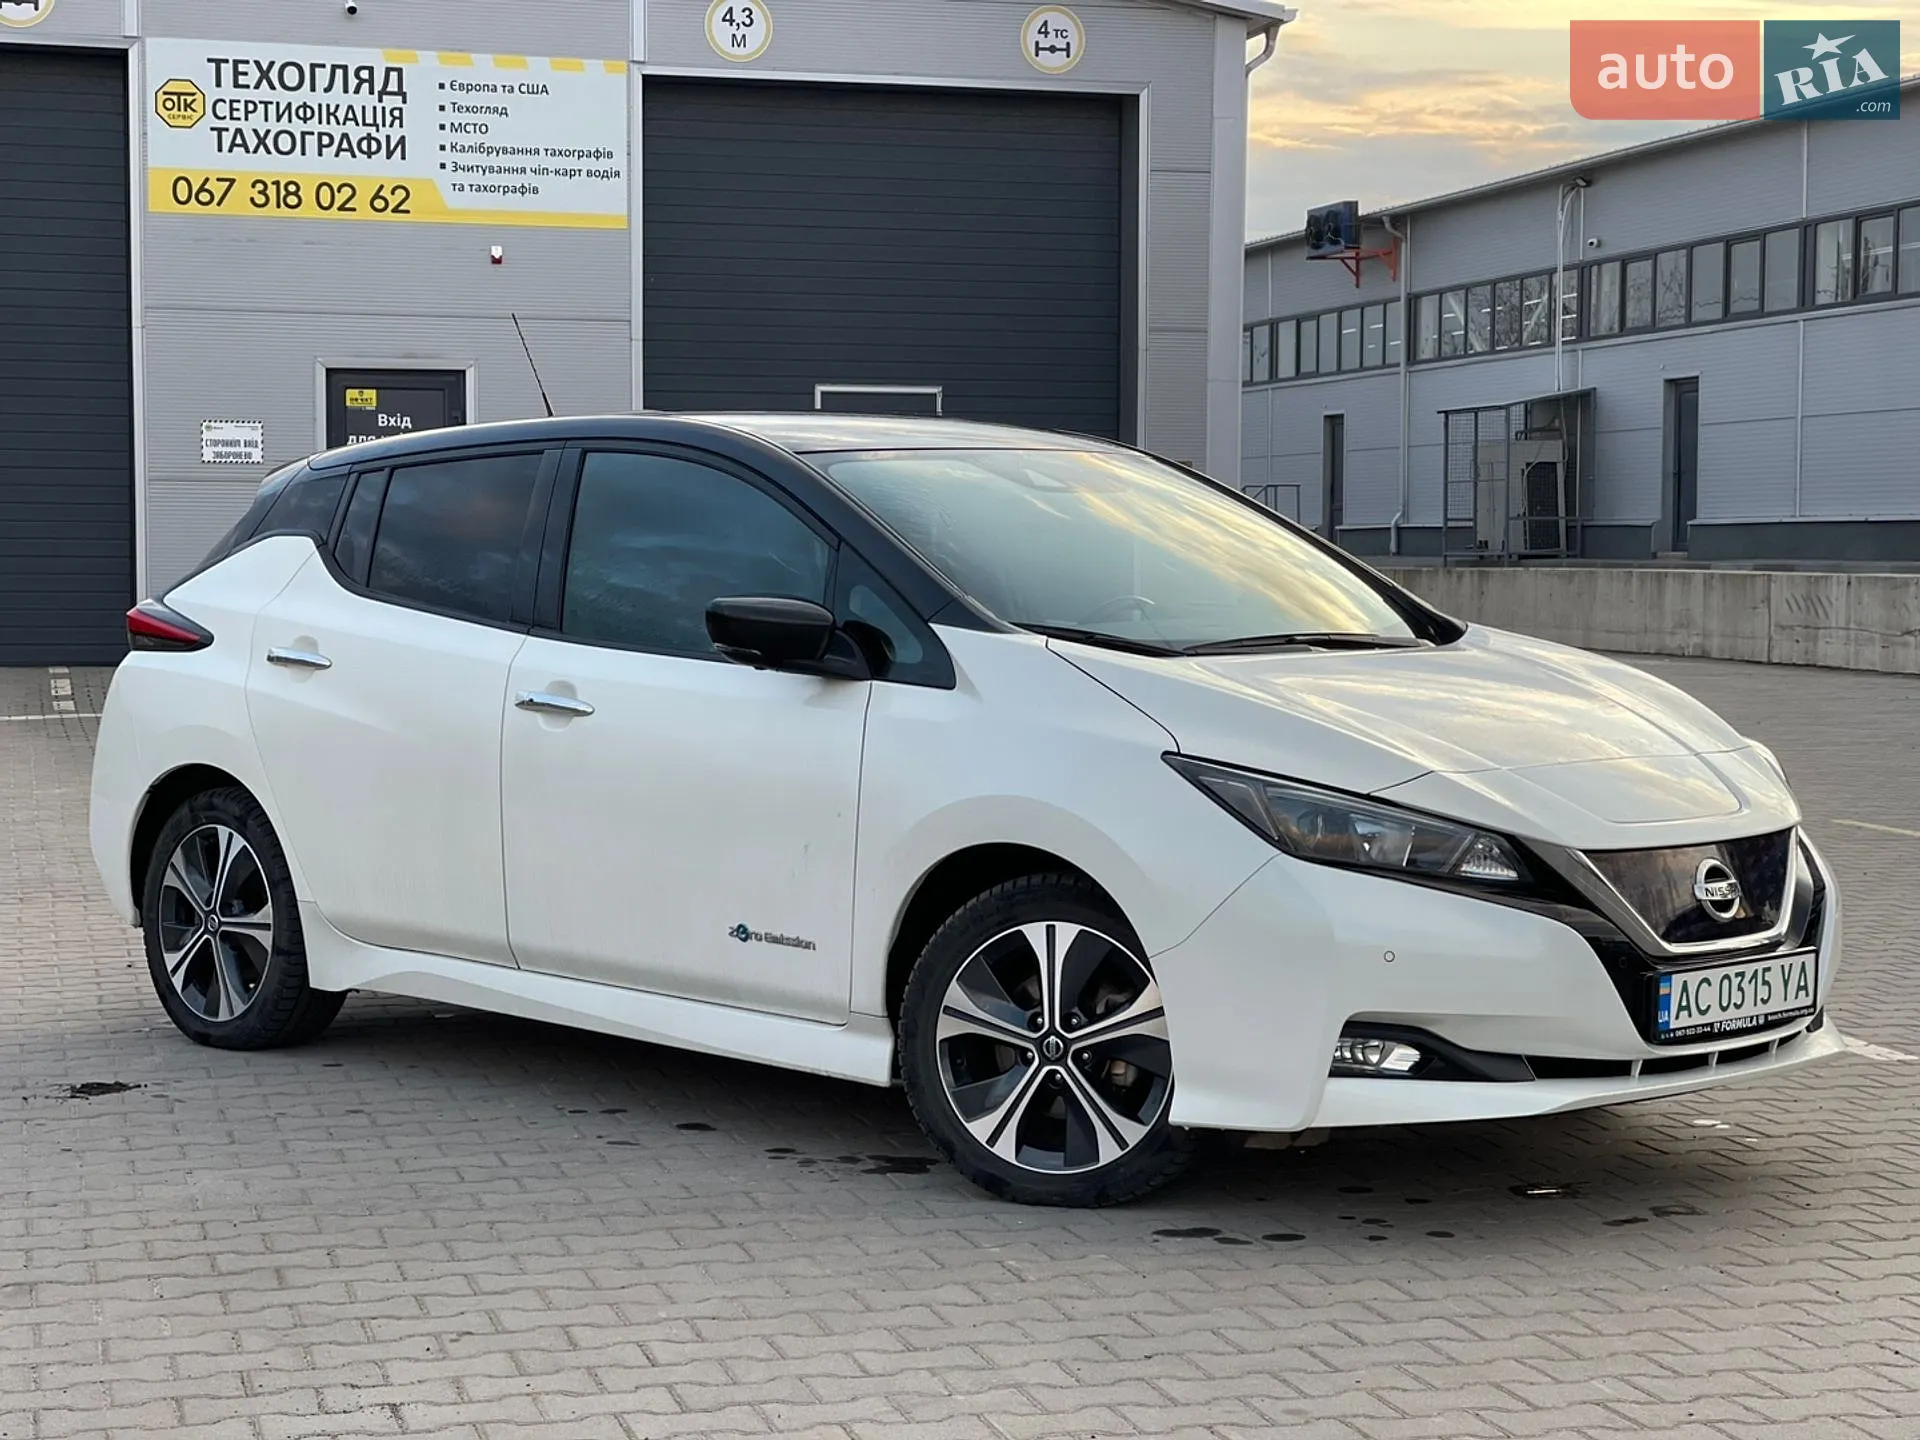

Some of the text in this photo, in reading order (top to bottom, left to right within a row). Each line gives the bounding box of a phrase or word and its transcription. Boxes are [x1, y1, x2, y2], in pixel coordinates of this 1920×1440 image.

[721, 6, 754, 31] 4,3
[1037, 19, 1050, 38] 4
[206, 57, 408, 104] ТЕХОГЛЯД
[450, 80, 549, 95] Європа та США
[162, 91, 198, 113] ОТК
[450, 102, 509, 117] Техогляд
[211, 98, 405, 132] СЕРТИФІКАЦІЯ
[450, 122, 489, 135] МСТО
[209, 126, 408, 160] ТАХОГРАФИ
[450, 142, 614, 161] Калібрування тахографів
[451, 161, 621, 181] Зчитування чіп-карт водія
[172, 175, 411, 214] 067 318 02 62
[451, 182, 539, 197] та тахографів
[378, 413, 412, 429] Вхід
[1675, 961, 1810, 1020] AC 0315 YA
[1657, 1010, 1669, 1023] UA
[1720, 1016, 1758, 1032] FORMULA
